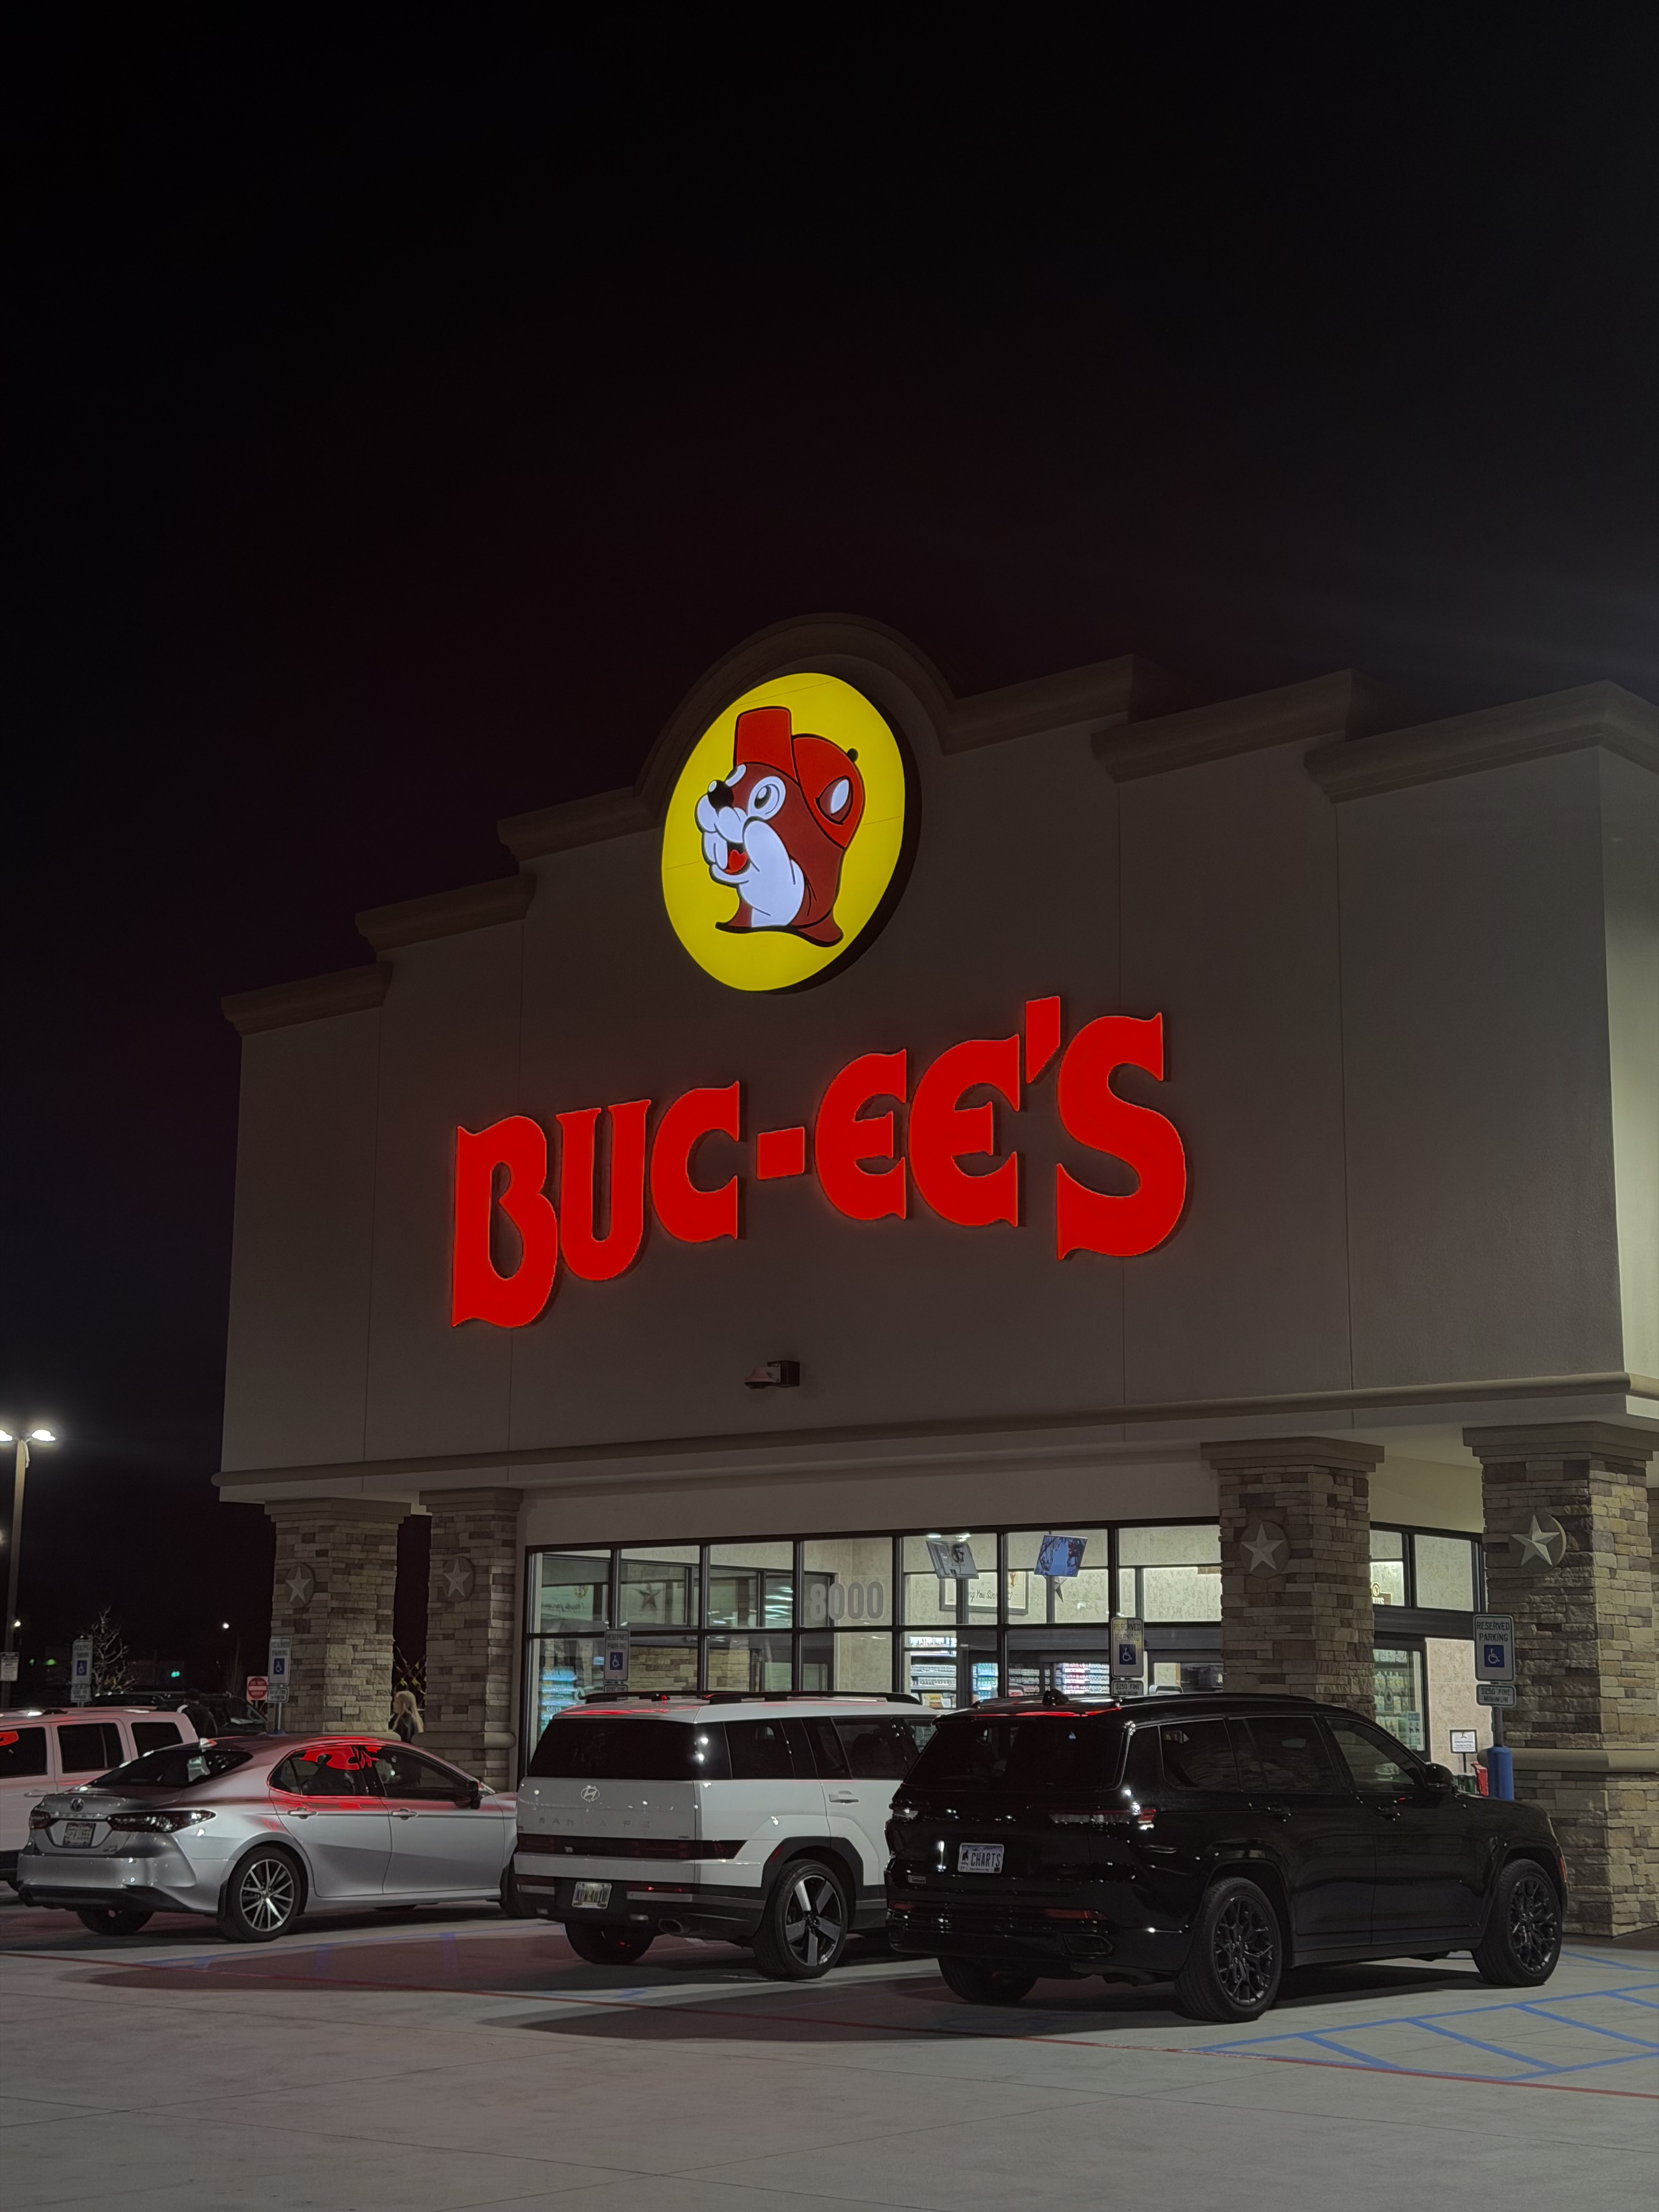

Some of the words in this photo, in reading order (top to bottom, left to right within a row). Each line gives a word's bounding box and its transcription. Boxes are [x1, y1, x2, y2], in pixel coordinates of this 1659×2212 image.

[452, 997, 1185, 1328] BUC-EE'S
[977, 1589, 985, 1599] You
[810, 1581, 884, 1621] 8000
[1476, 1622, 1510, 1631] RESERVED
[1115, 1633, 1139, 1642] PARKING
[1479, 1633, 1509, 1642] PARKING
[539, 1816, 607, 1827] SANA
[970, 1852, 1001, 1867] CHARTS
